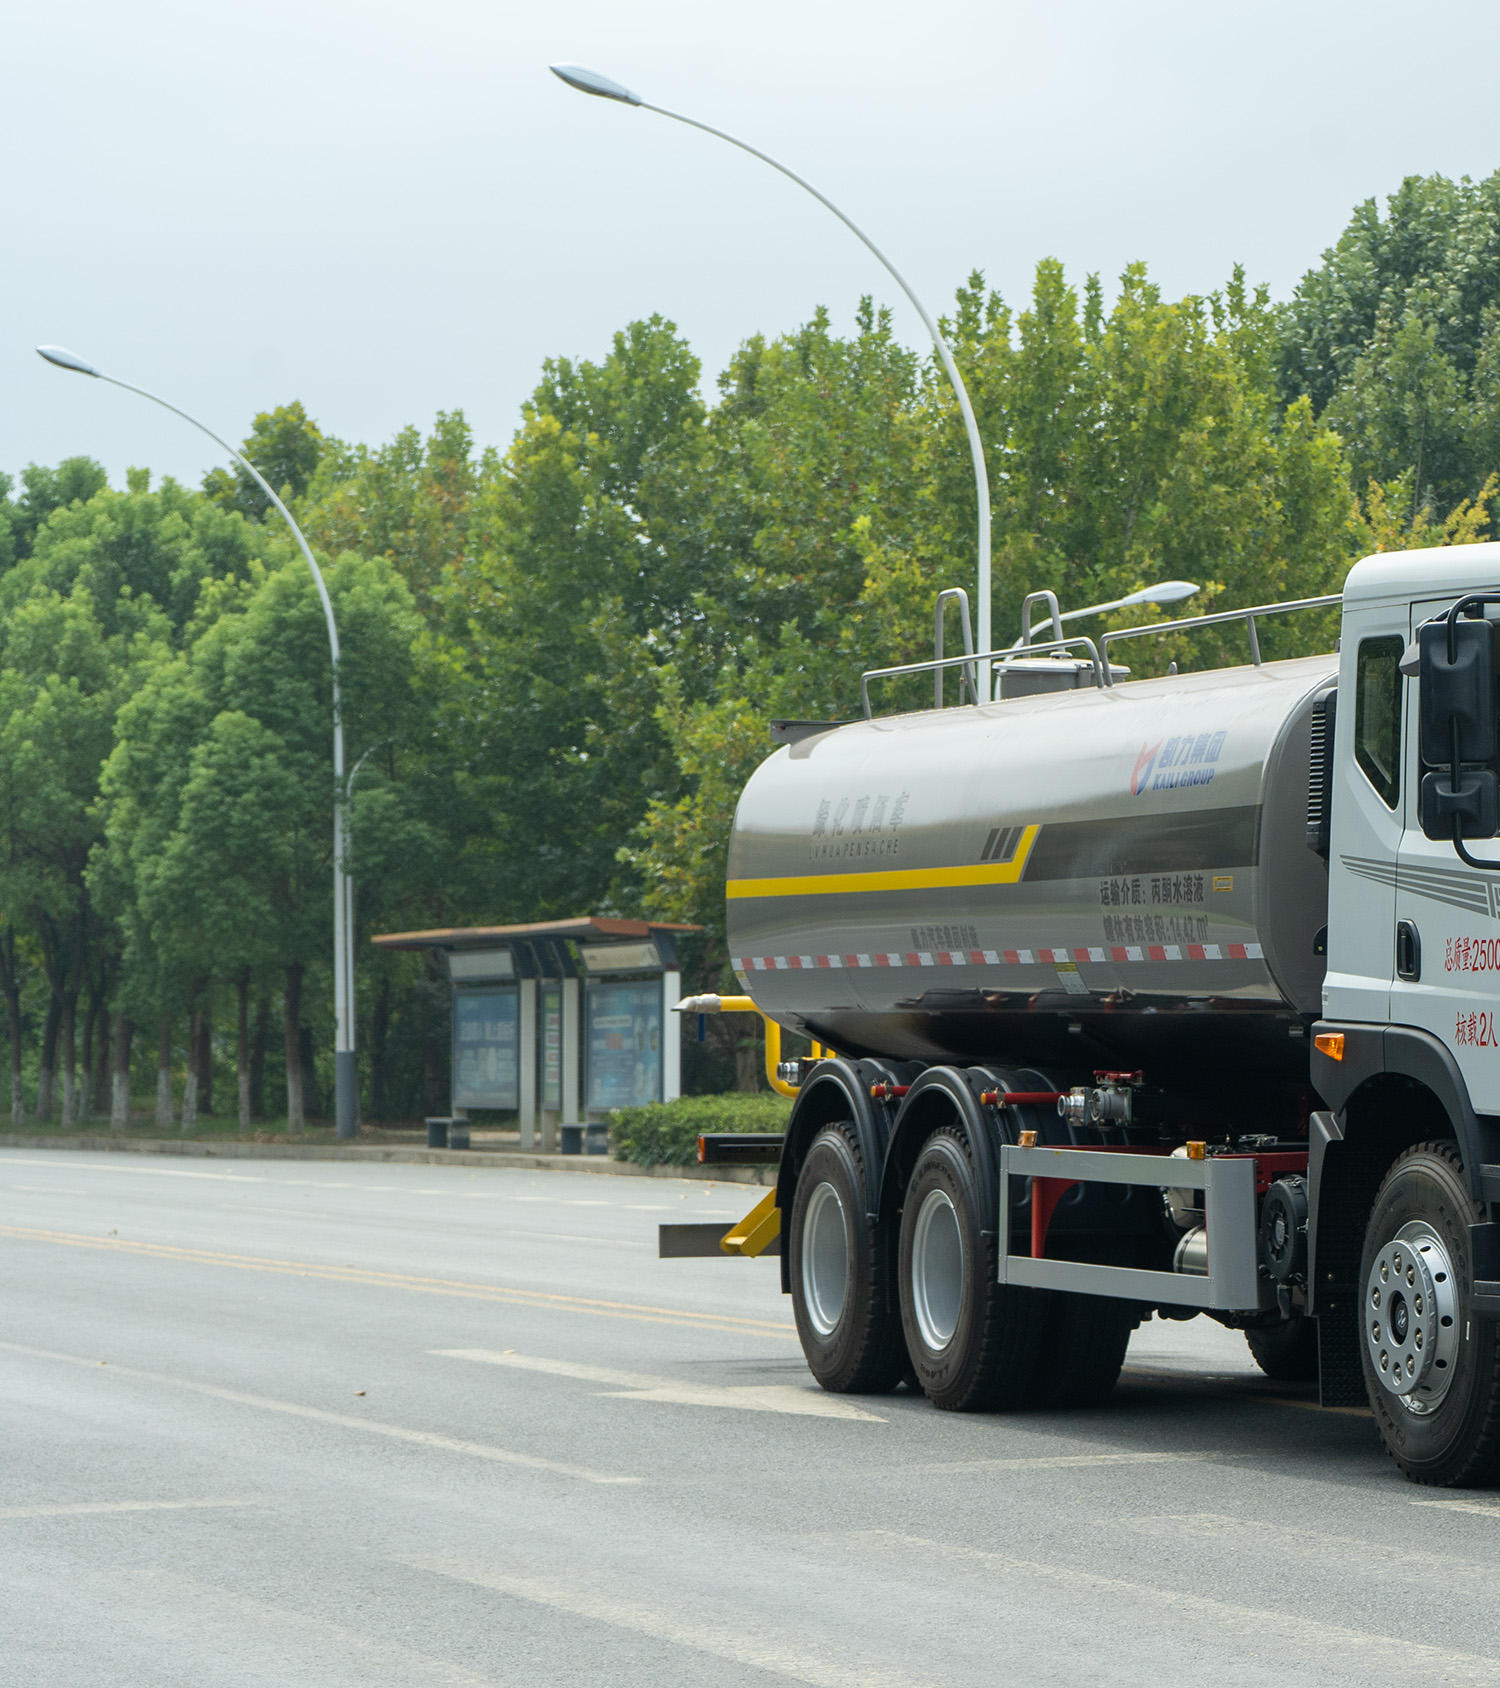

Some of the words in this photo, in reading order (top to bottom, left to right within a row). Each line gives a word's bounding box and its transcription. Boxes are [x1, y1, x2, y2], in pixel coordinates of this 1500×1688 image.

[1158, 731, 1228, 768] 凯力集团
[1152, 771, 1180, 791] KAILI
[1180, 768, 1215, 788] GROUP
[1455, 1011, 1499, 1047] 核载2人
